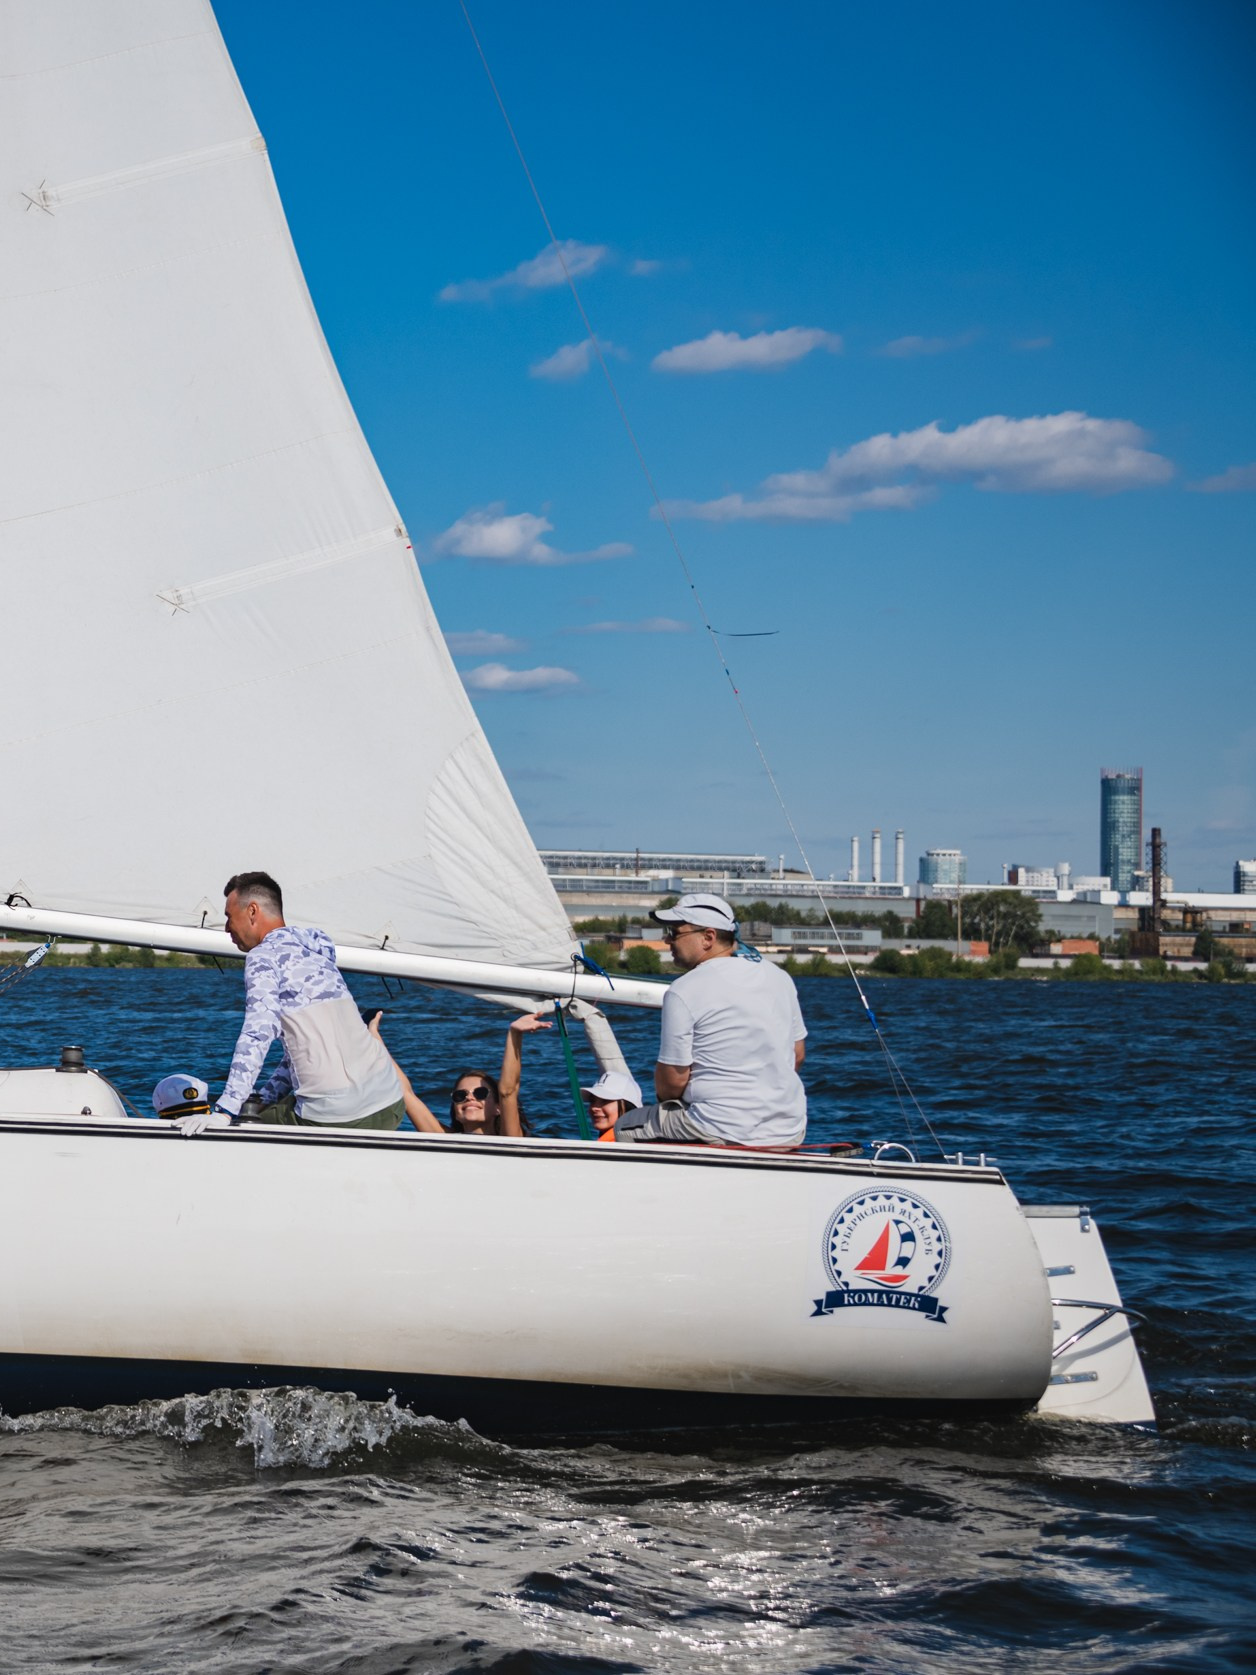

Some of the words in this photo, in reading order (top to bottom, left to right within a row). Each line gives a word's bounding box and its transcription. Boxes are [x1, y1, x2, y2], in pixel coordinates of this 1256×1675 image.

[840, 1203, 895, 1252] ГУБЕРНСКИЙ
[899, 1208, 933, 1256] ЯХТ-КЛУБ
[844, 1292, 921, 1309] КОМАТЕК
